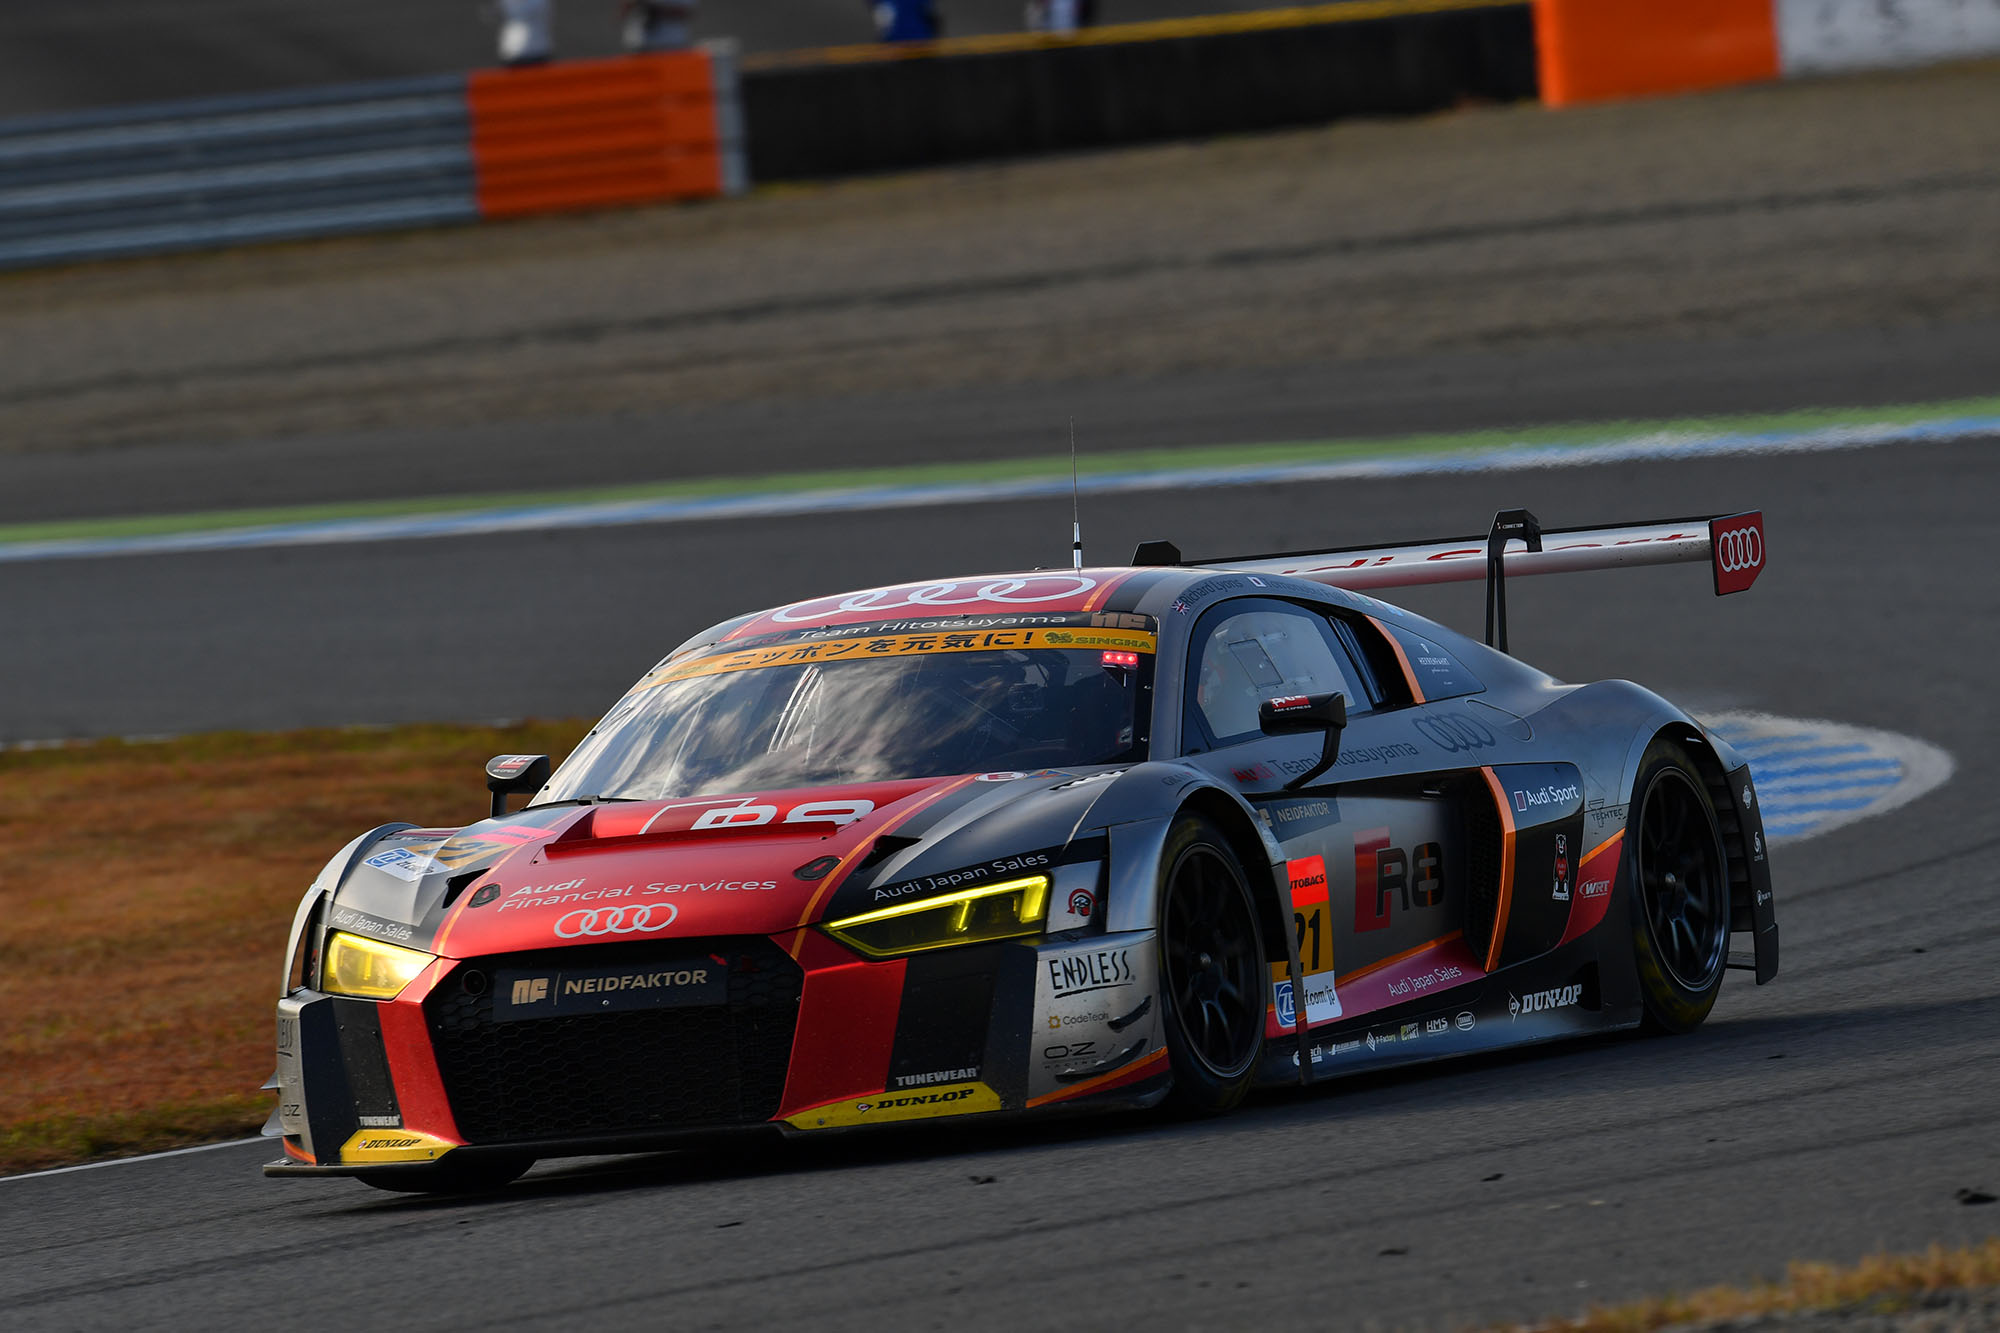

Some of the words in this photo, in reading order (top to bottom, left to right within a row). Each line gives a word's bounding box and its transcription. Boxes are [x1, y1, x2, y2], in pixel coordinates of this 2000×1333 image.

[1214, 579, 1244, 593] Lyons
[800, 625, 870, 640] Team
[878, 614, 1067, 632] Hitotsuyama
[1075, 636, 1152, 649] SINGHA
[1267, 757, 1318, 776] Team
[1526, 787, 1552, 806] Audi
[1548, 784, 1579, 806] Sport
[1277, 802, 1330, 823] NEIDFAKTOR
[1591, 808, 1624, 822] TECHTEC
[874, 881, 921, 901] Audi
[926, 868, 988, 891] Japan
[992, 852, 1049, 873] Sales
[1585, 879, 1610, 895] WRT
[498, 885, 633, 913] Financial
[641, 878, 777, 895] Services
[508, 878, 586, 899] Audi
[333, 910, 359, 926] Audi
[351, 915, 383, 933] Japan
[381, 923, 413, 940] Sales
[1049, 950, 1130, 990] ENDLESS
[565, 969, 707, 995] NEIDFAKTOR
[1388, 978, 1411, 997] Audi
[1408, 974, 1438, 991] Japan
[1434, 966, 1463, 982] Sales
[1521, 984, 1582, 1014] DUNLOP
[1426, 1017, 1448, 1031] HMS
[896, 1067, 977, 1087] TUNEWEAR
[877, 1089, 975, 1110] DUNLOP
[365, 1138, 421, 1149] DUNLOP
